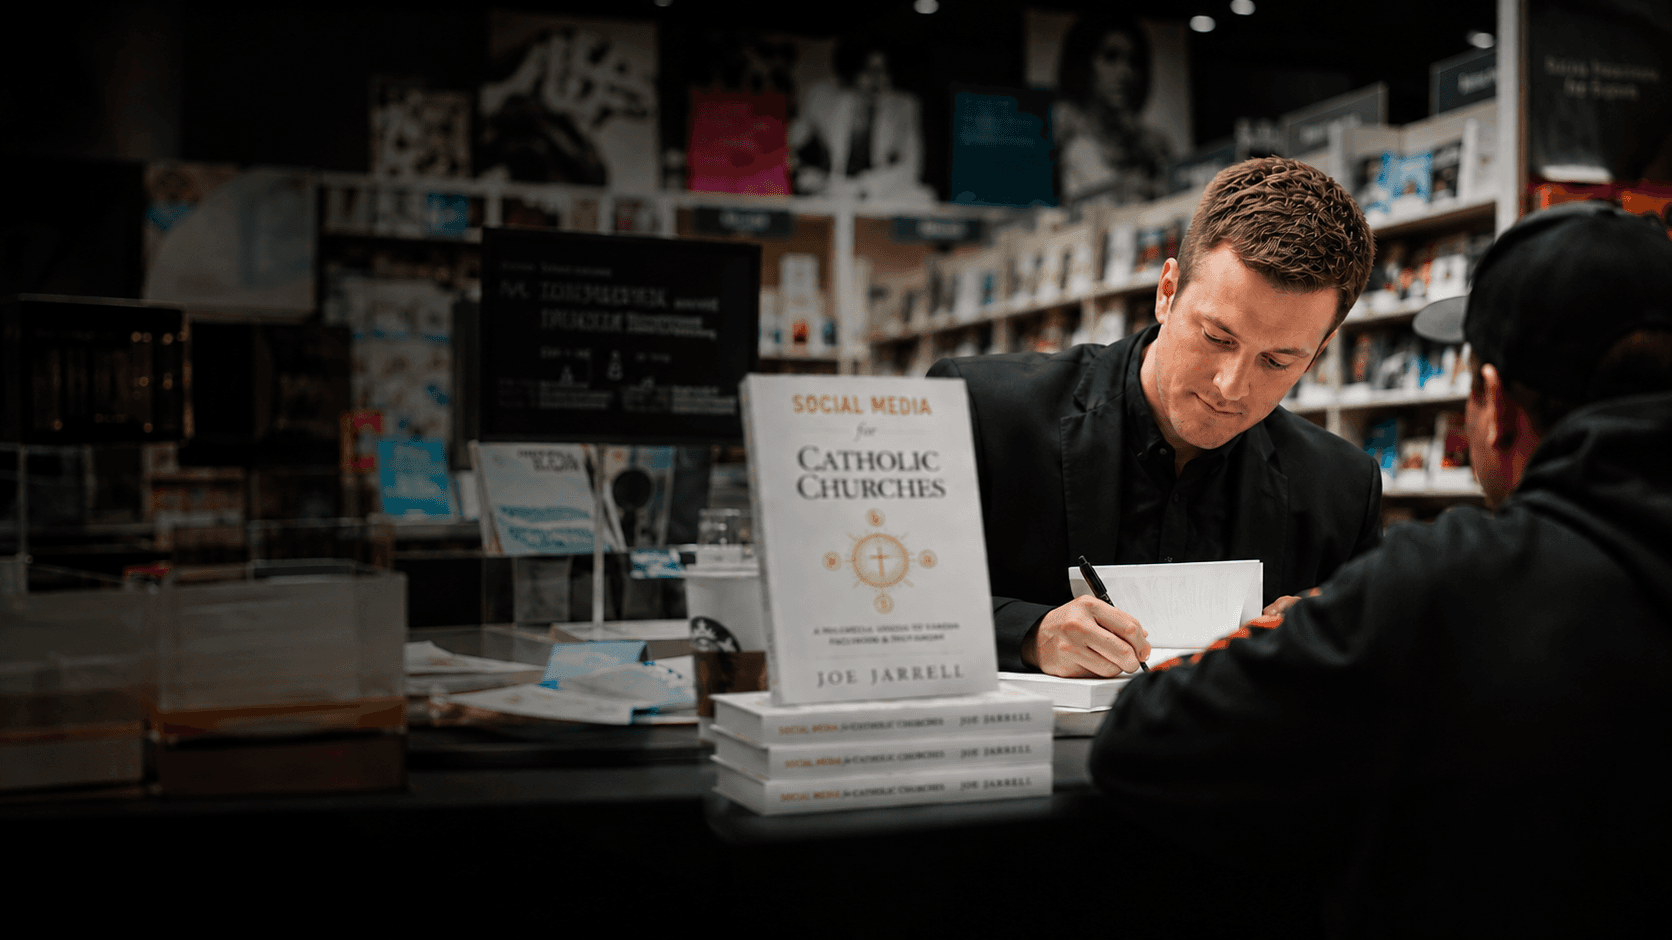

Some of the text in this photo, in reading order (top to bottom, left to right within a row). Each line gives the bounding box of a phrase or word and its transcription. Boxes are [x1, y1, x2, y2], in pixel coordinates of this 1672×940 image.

[792, 394, 932, 415] SOCIAL MEDIA
[853, 422, 877, 442] for
[797, 445, 940, 473] CATHOLIC
[797, 474, 946, 500] CHURCHES
[817, 665, 965, 688] JOE JARRELL
[983, 712, 1032, 724] JARRELL
[983, 744, 1032, 756] JARRELL
[983, 777, 1032, 789] JARRELL
